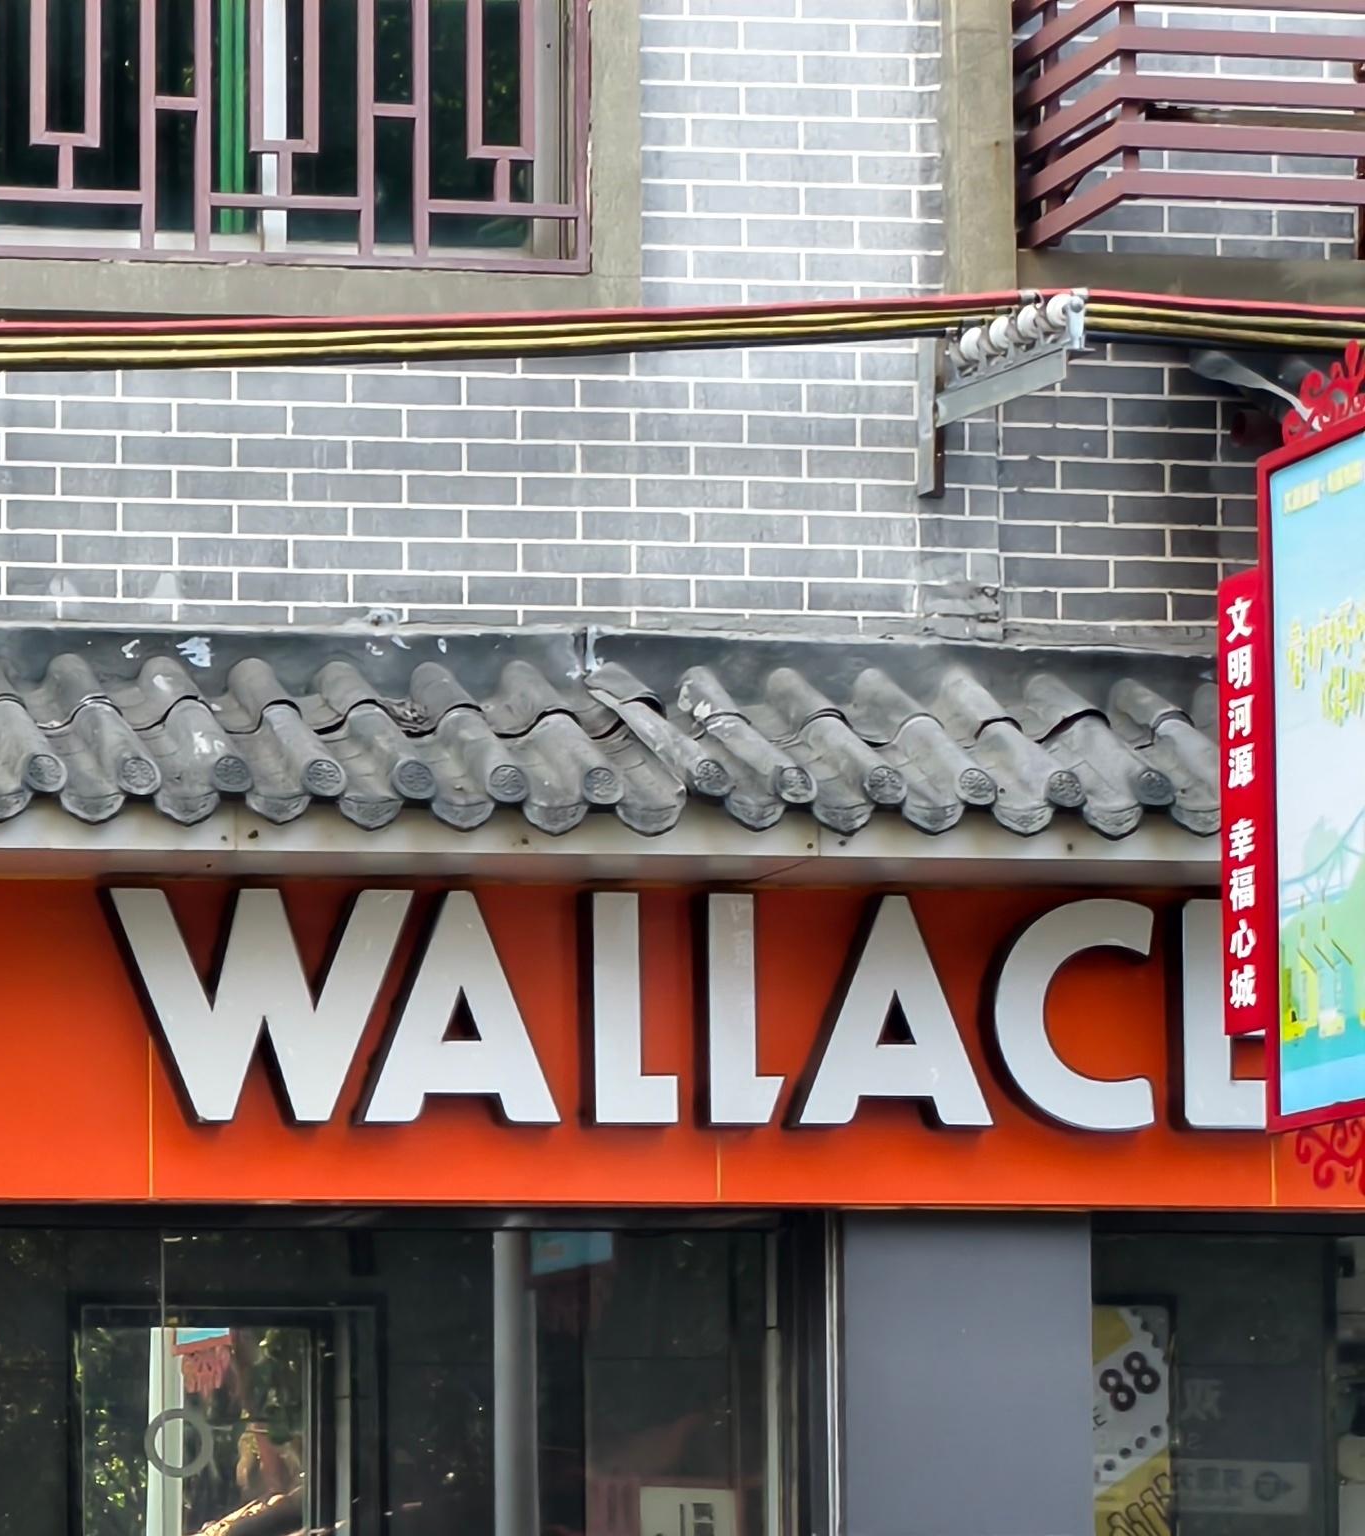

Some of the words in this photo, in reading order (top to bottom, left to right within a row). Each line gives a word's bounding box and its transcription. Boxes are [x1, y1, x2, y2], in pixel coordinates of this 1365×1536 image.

[1225, 597, 1256, 789] 文明河源
[1227, 818, 1257, 1009] 幸福心城
